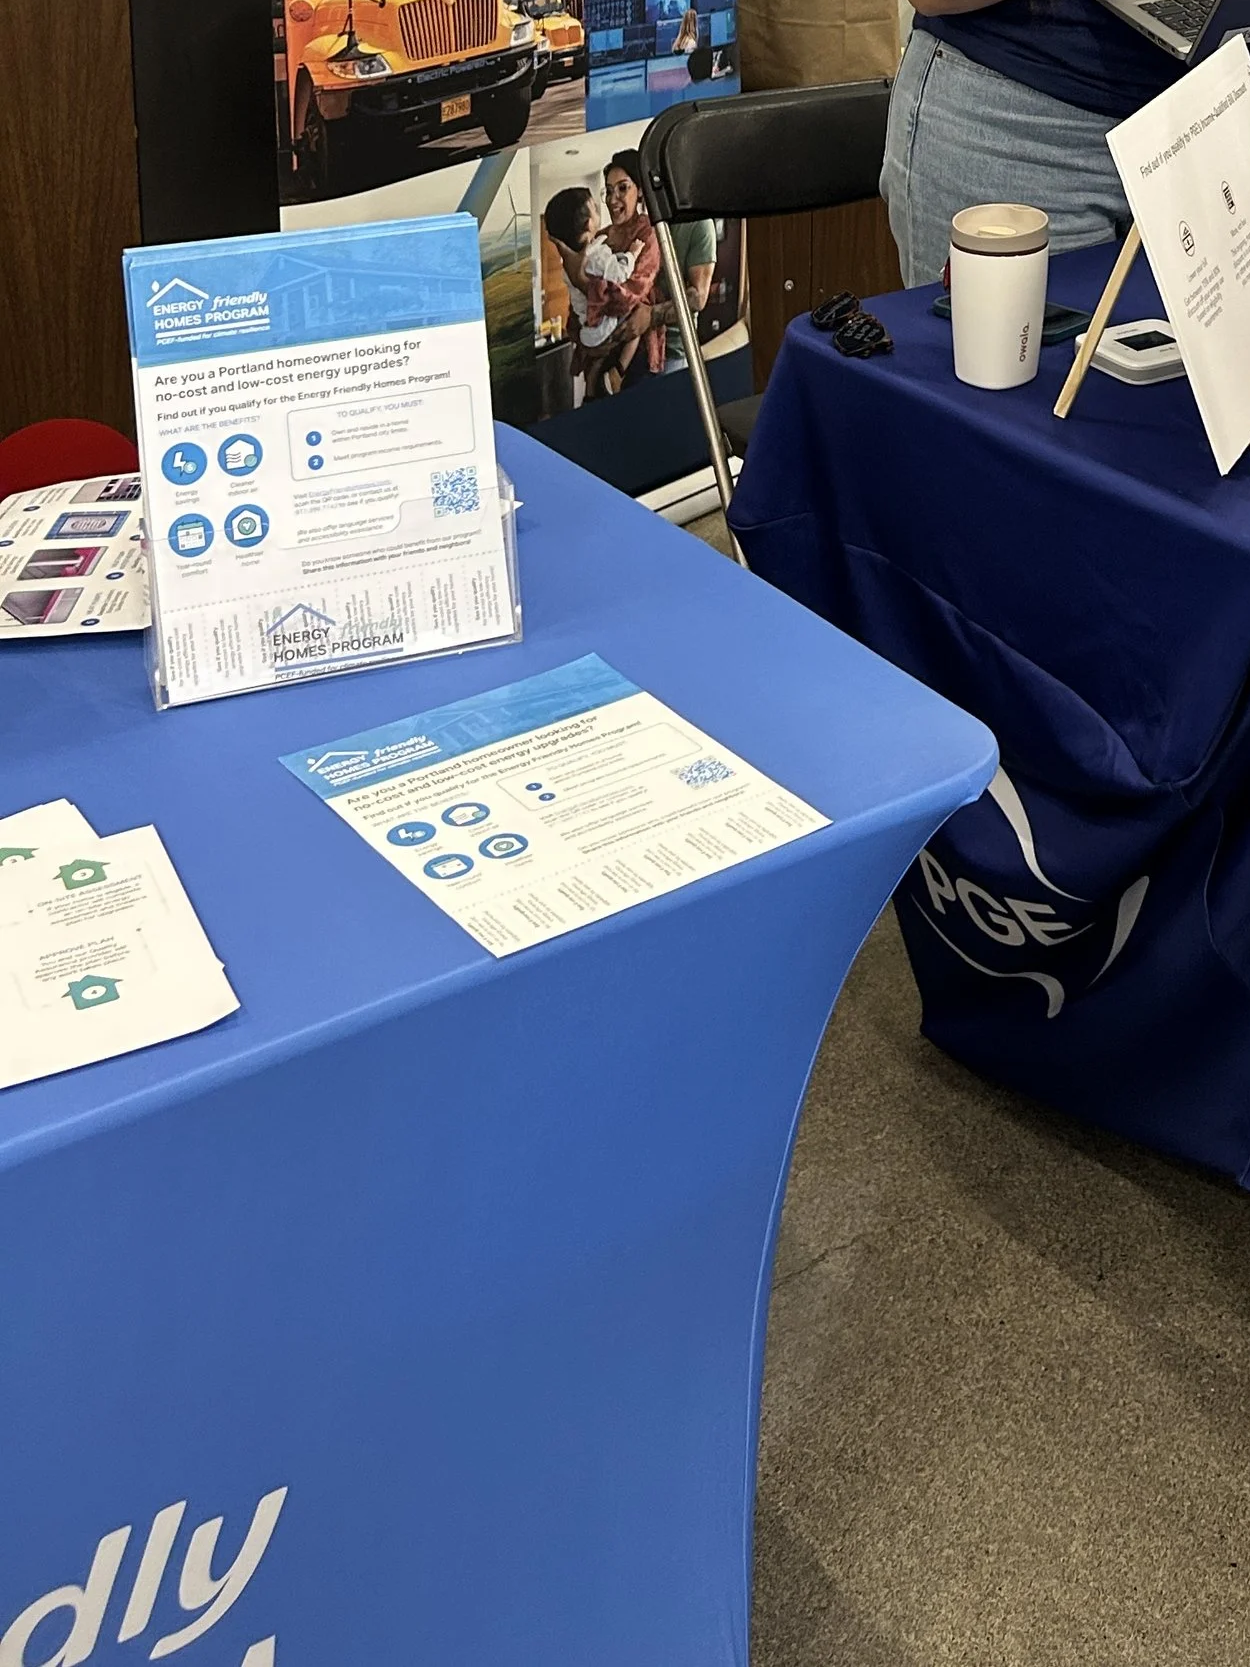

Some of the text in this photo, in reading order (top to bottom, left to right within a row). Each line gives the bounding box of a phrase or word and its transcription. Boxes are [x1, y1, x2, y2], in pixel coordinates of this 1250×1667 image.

[417, 67, 449, 83] Electric
[153, 290, 268, 317] ENERGY friendly
[154, 305, 270, 330] HOMES PROGRAM
[154, 340, 421, 386] Are you a Portland homeowner looking for
[155, 355, 409, 401] no-cost and low-cost energy upgrades?
[157, 411, 178, 421] Find
[181, 409, 197, 417] out
[199, 406, 206, 414] if
[208, 405, 226, 415] you
[228, 399, 261, 411] qualify
[297, 390, 331, 400] Energy
[333, 383, 371, 394] Friendly
[373, 378, 406, 388] Homes
[408, 370, 450, 383] Program!
[273, 627, 330, 646] ENERGY
[274, 632, 404, 663] HOMES PROGRAM
[317, 753, 365, 774] ENERGY
[374, 735, 426, 759] friendly
[323, 762, 370, 779] HOMES
[371, 740, 434, 764] PROGRAM
[347, 794, 369, 804] Are
[371, 785, 396, 797] you
[407, 762, 461, 783] Portland
[462, 738, 532, 765] homeowner
[534, 723, 580, 740] looking
[579, 716, 597, 724] for
[354, 791, 405, 811] no-cost
[407, 782, 431, 793] and
[431, 763, 487, 784] low-cost
[489, 748, 530, 765] energy
[533, 725, 593, 750] upgrades?
[919, 848, 1096, 947] PGE
[0, 1486, 288, 1667] dly
